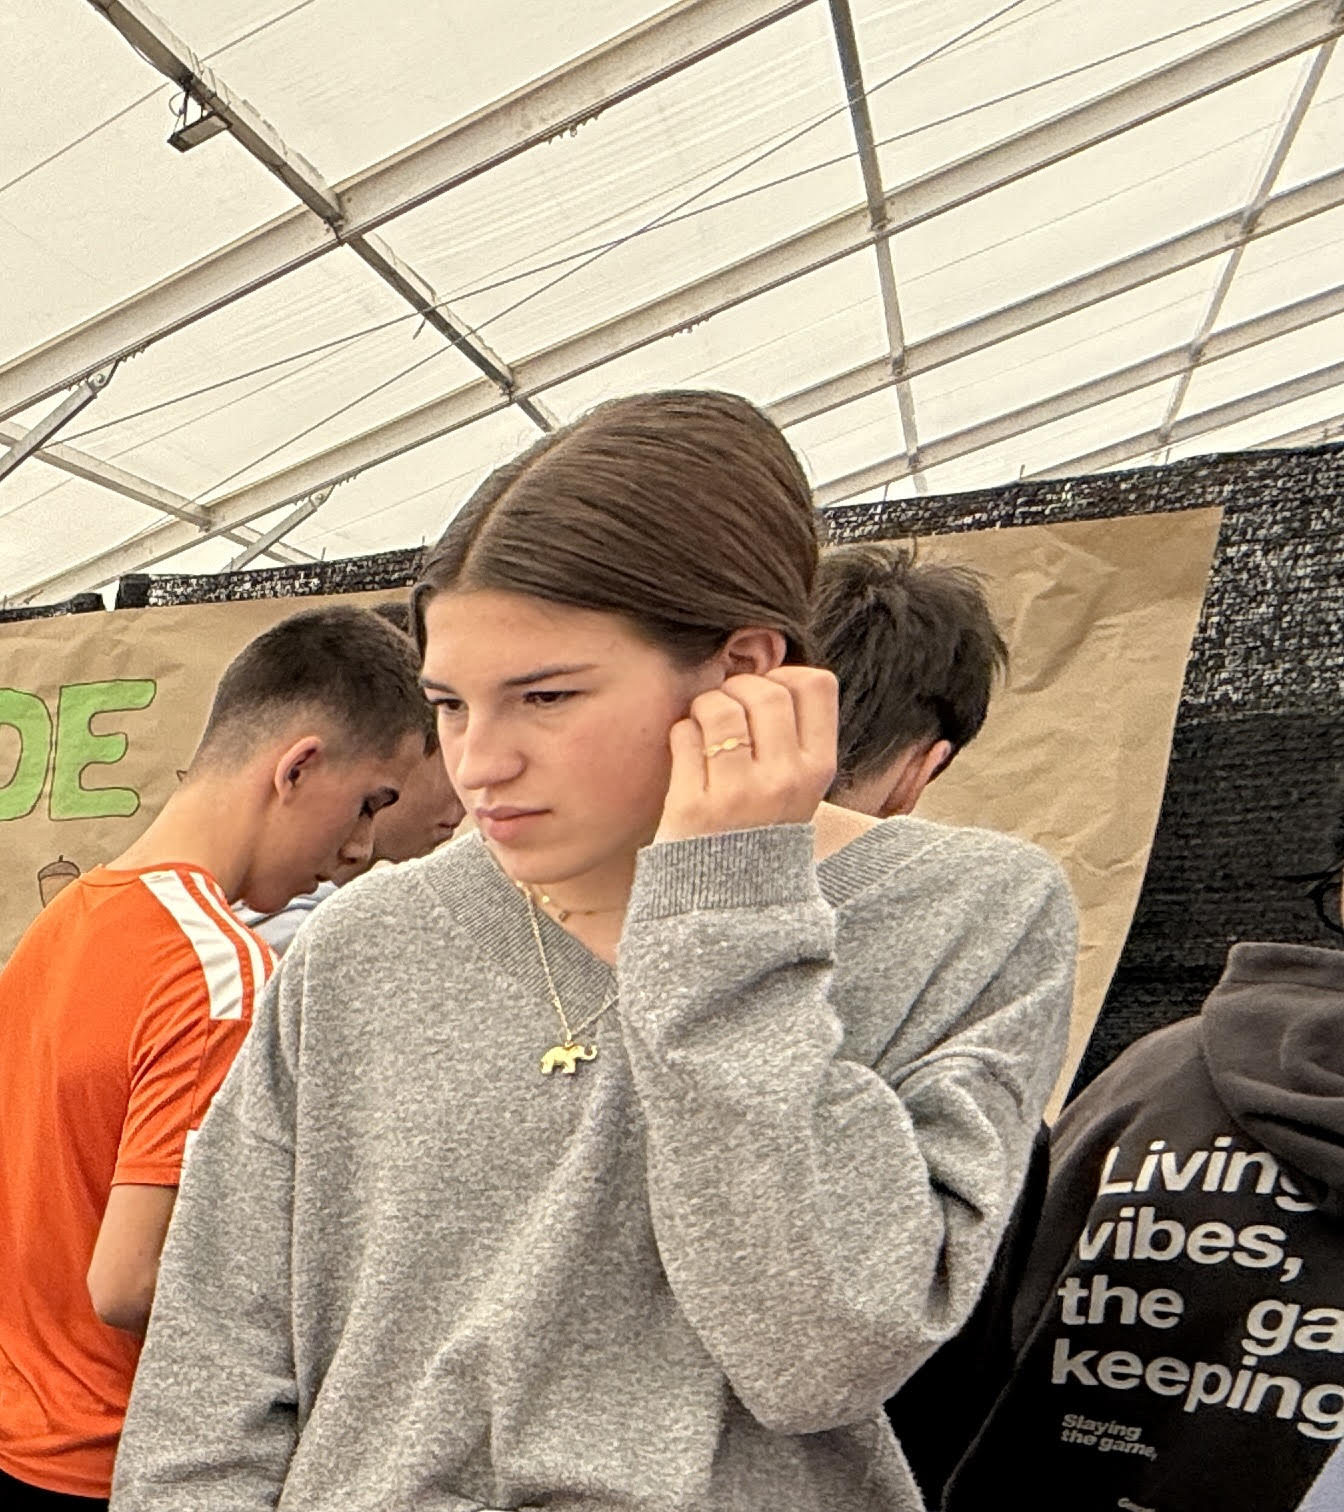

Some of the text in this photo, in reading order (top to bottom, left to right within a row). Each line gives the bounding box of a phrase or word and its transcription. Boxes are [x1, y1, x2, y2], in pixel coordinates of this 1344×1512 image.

[1077, 1206, 1304, 1283] vibes,
[1057, 1274, 1185, 1329] the
[1050, 1337, 1344, 1440] keeping
[1060, 1427, 1098, 1446] the
